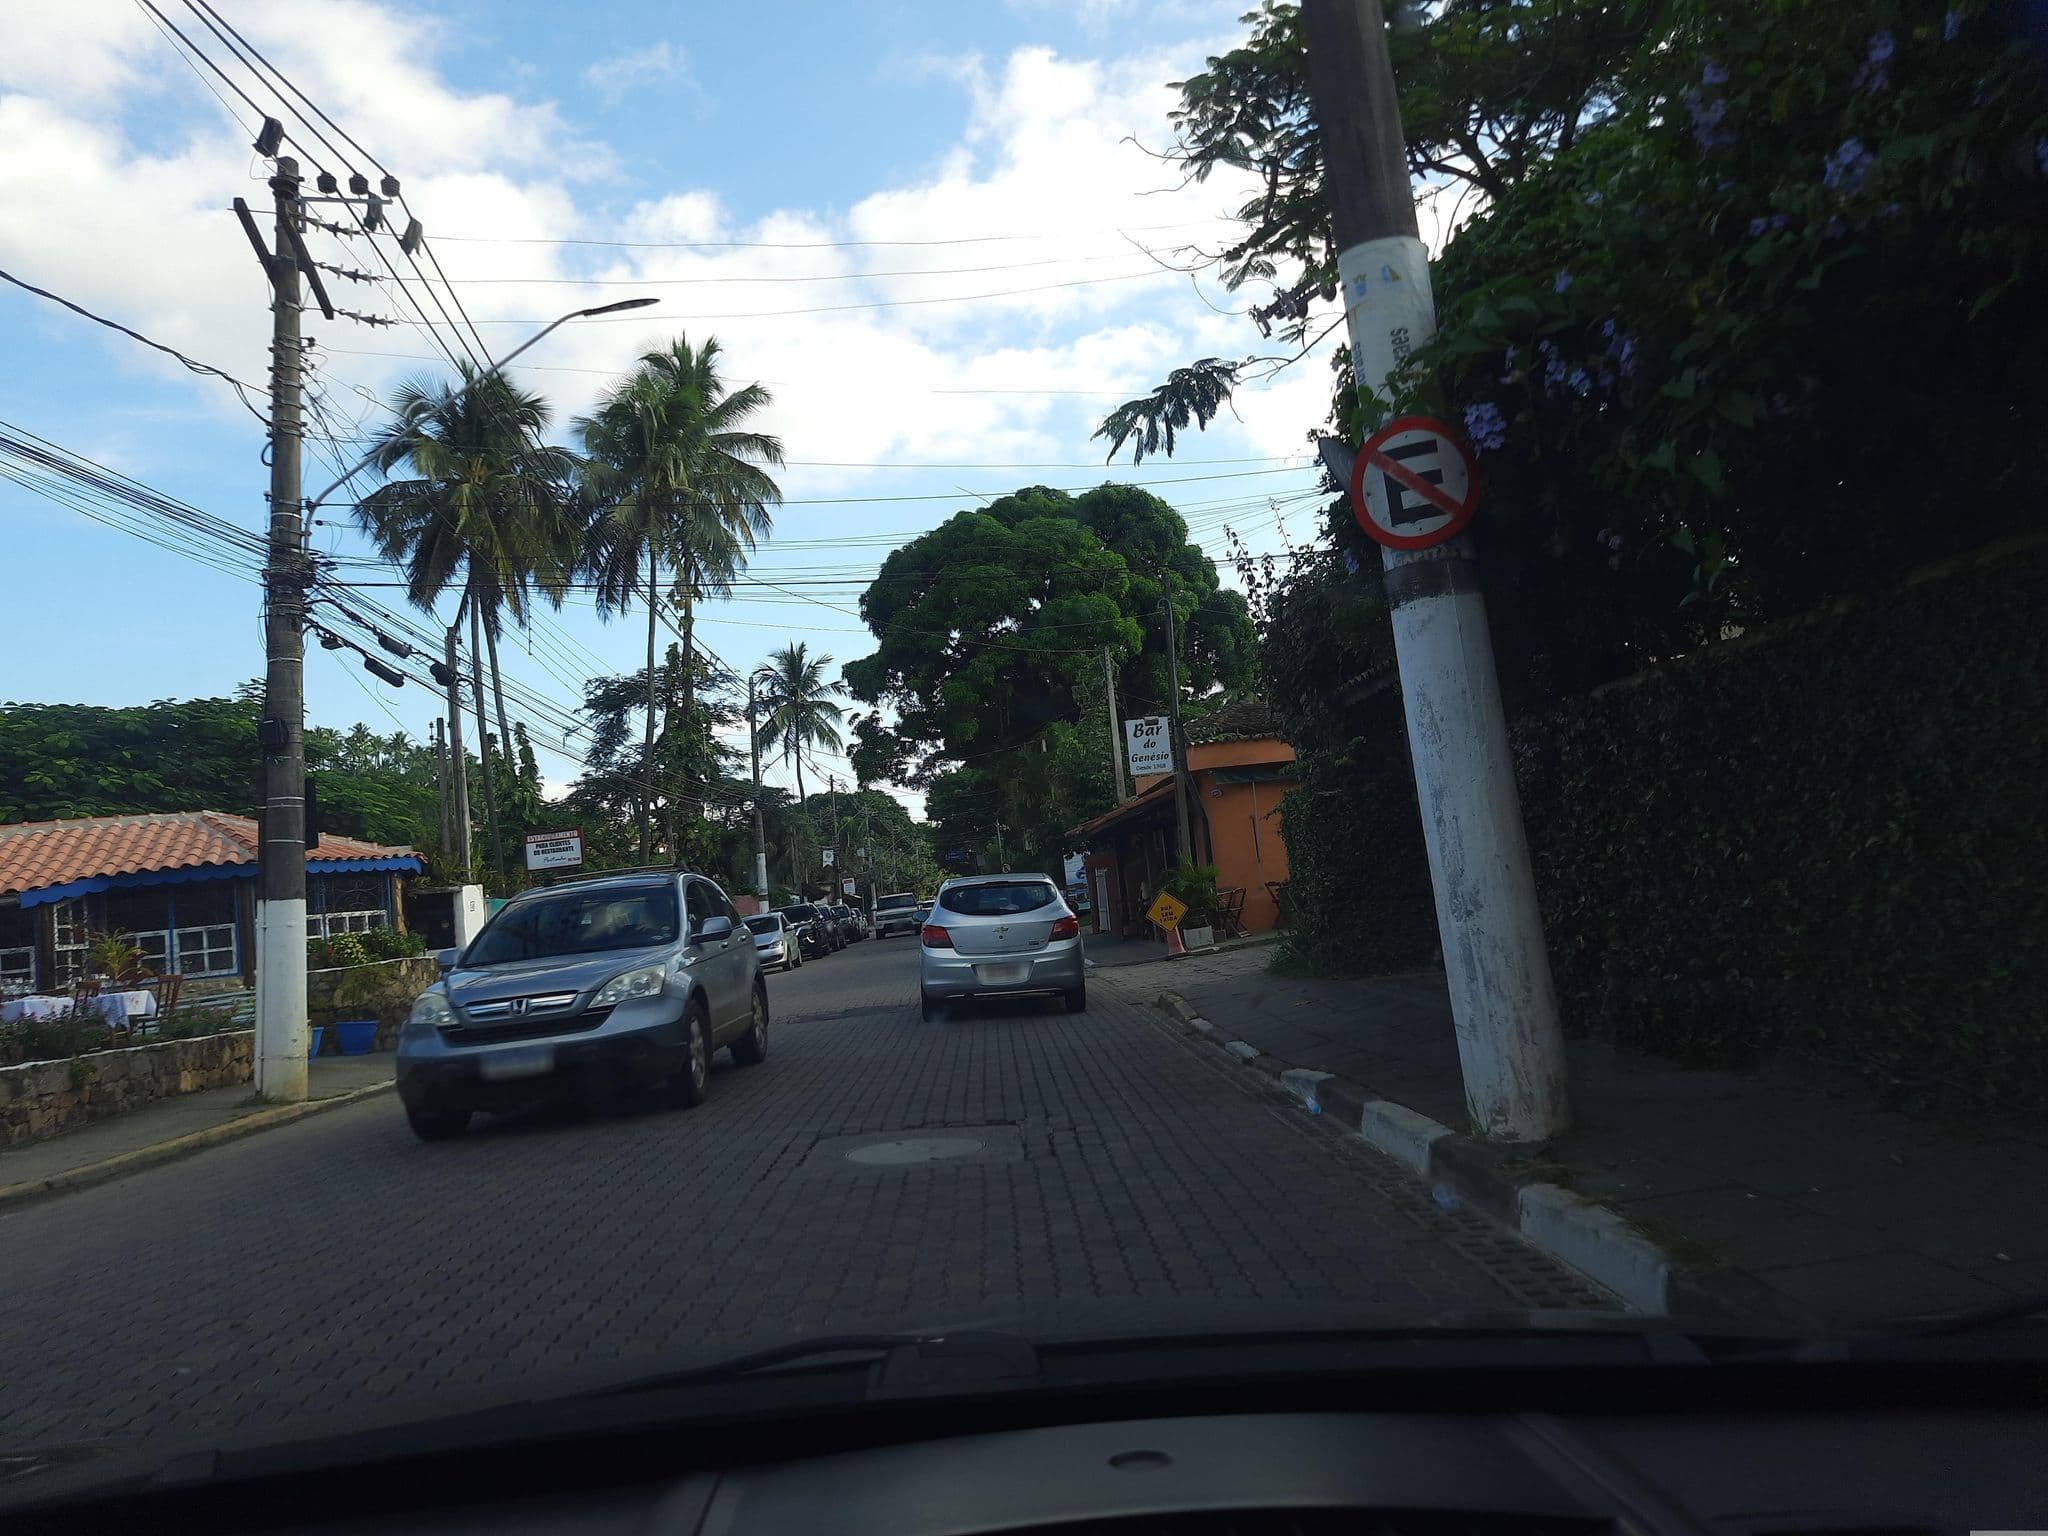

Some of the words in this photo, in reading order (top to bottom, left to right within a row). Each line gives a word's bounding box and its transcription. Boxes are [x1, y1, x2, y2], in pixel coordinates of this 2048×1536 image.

[1133, 722, 1162, 738] Bar
[1143, 738, 1156, 748] do
[1131, 752, 1169, 763] Genésio
